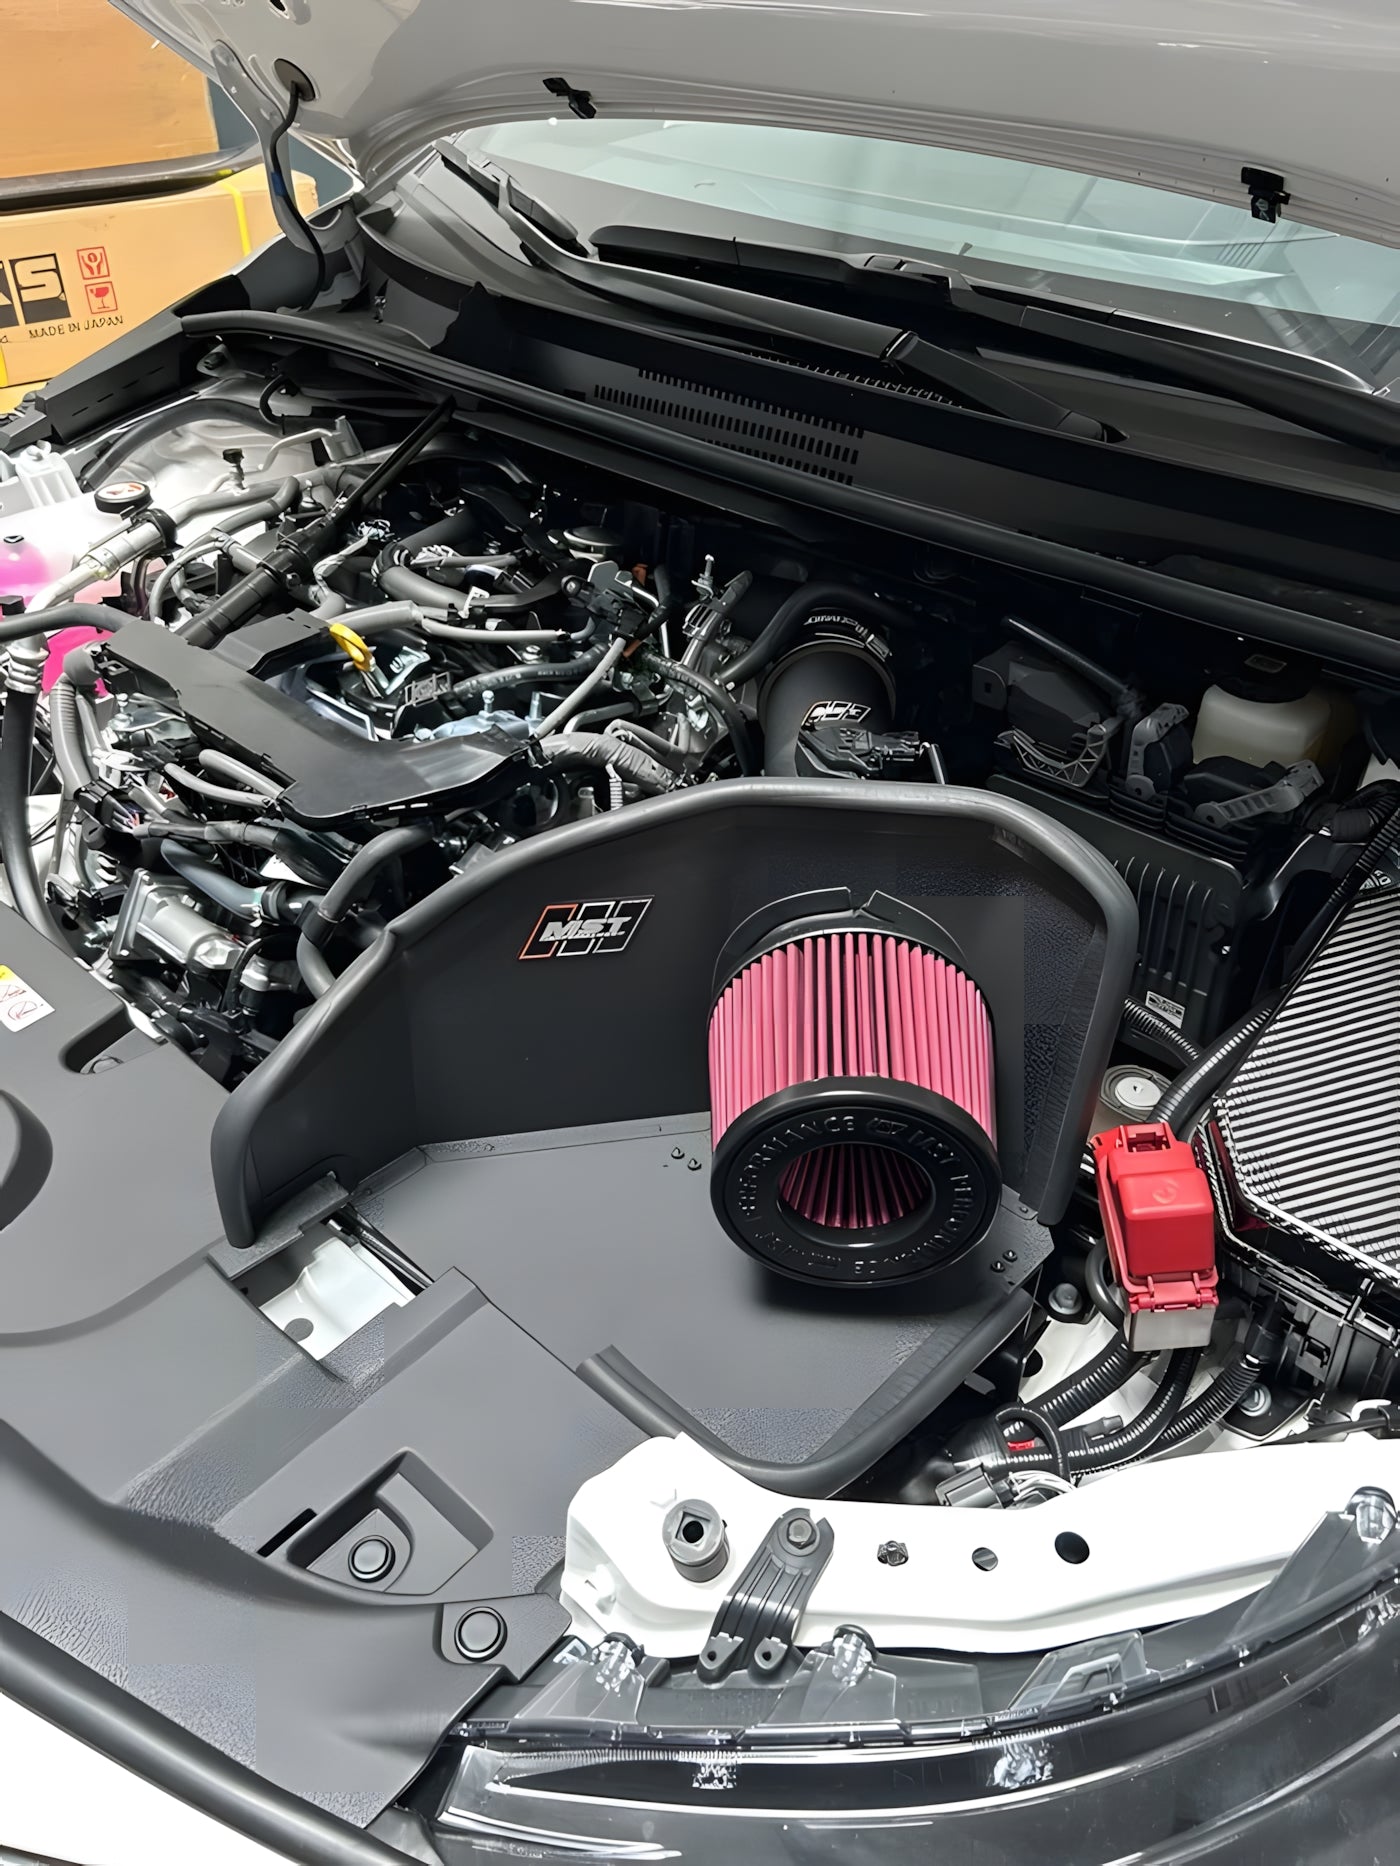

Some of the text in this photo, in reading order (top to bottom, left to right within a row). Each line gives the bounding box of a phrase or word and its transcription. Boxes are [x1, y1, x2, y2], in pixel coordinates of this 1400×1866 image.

[29, 316, 124, 338] MADE IN JAPAN
[539, 916, 632, 942] MST
